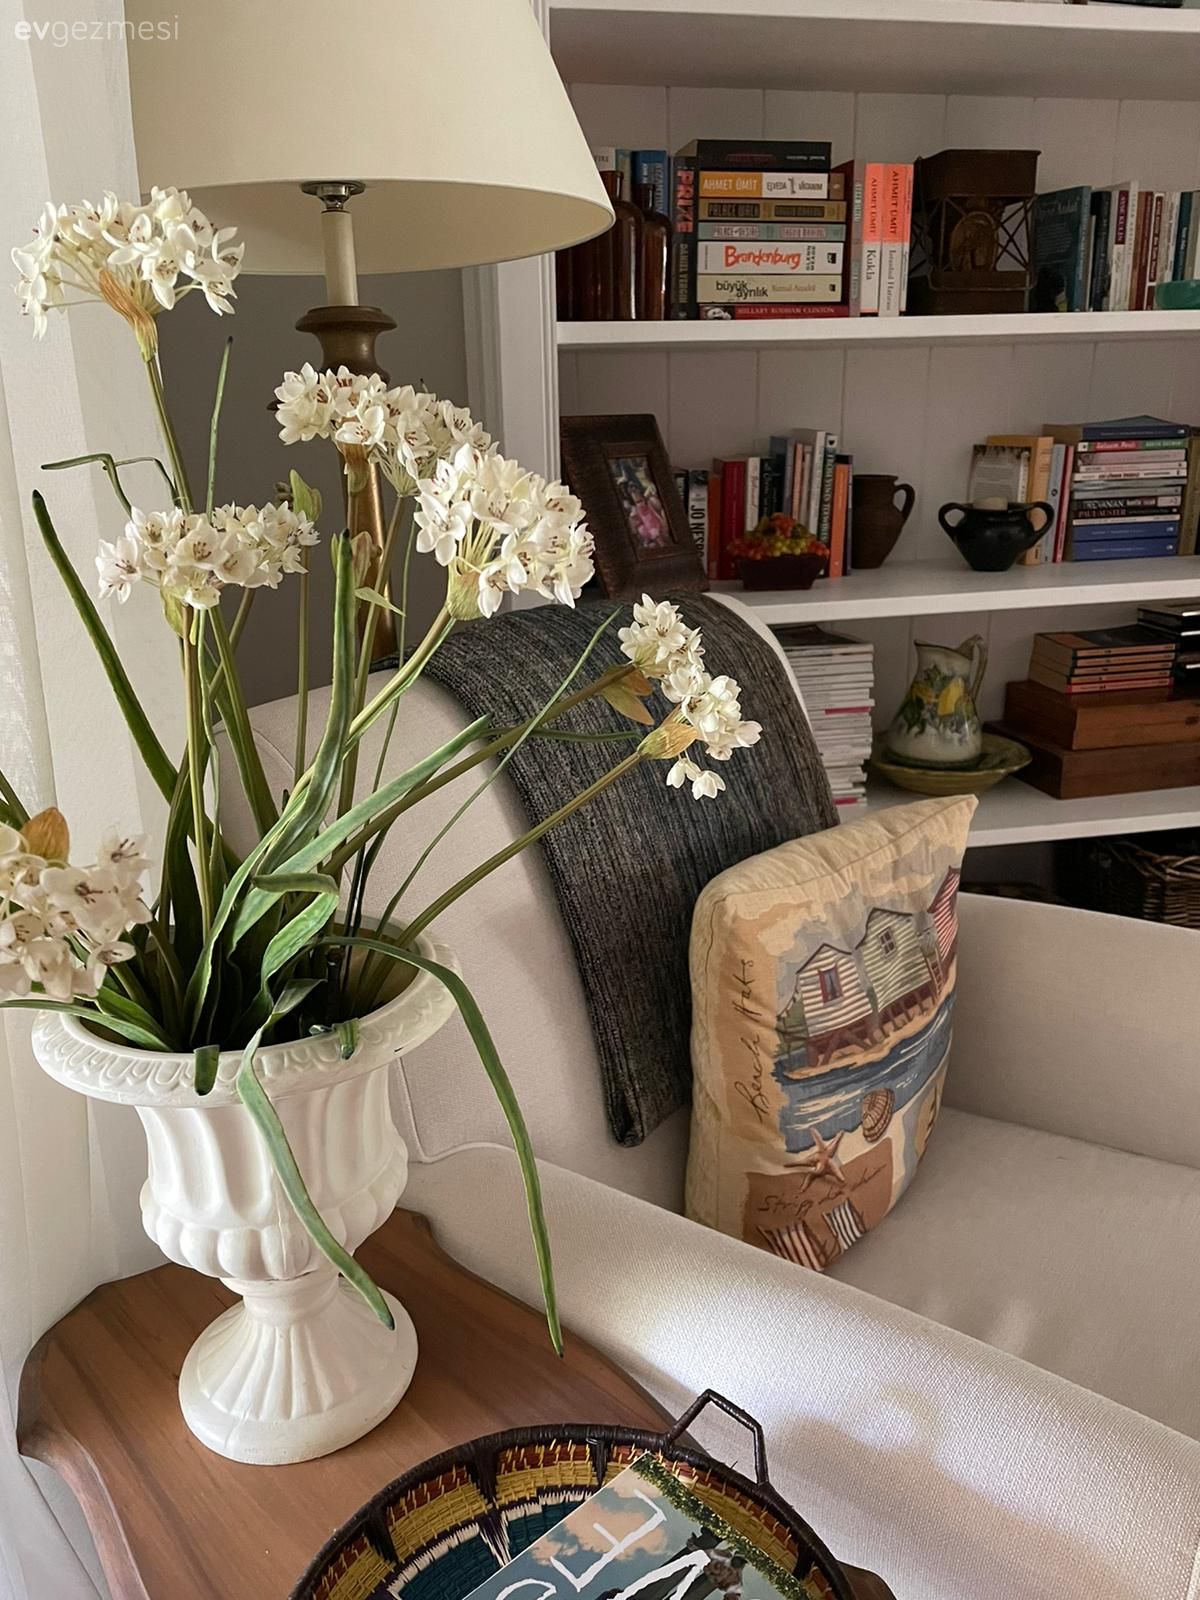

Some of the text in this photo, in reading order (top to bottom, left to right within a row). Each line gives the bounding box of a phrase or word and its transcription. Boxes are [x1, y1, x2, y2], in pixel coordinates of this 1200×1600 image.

[702, 177, 733, 192] AHMET
[870, 177, 879, 209] AHMET
[891, 170, 900, 208] AHMET
[675, 170, 694, 233] PRIZE
[724, 245, 802, 270] Brandenburg
[865, 249, 877, 281] Kukla
[716, 280, 749, 293] büyük
[737, 307, 769, 315] HILLARY
[690, 504, 705, 519] JO
[734, 1033, 770, 1123] Beach
